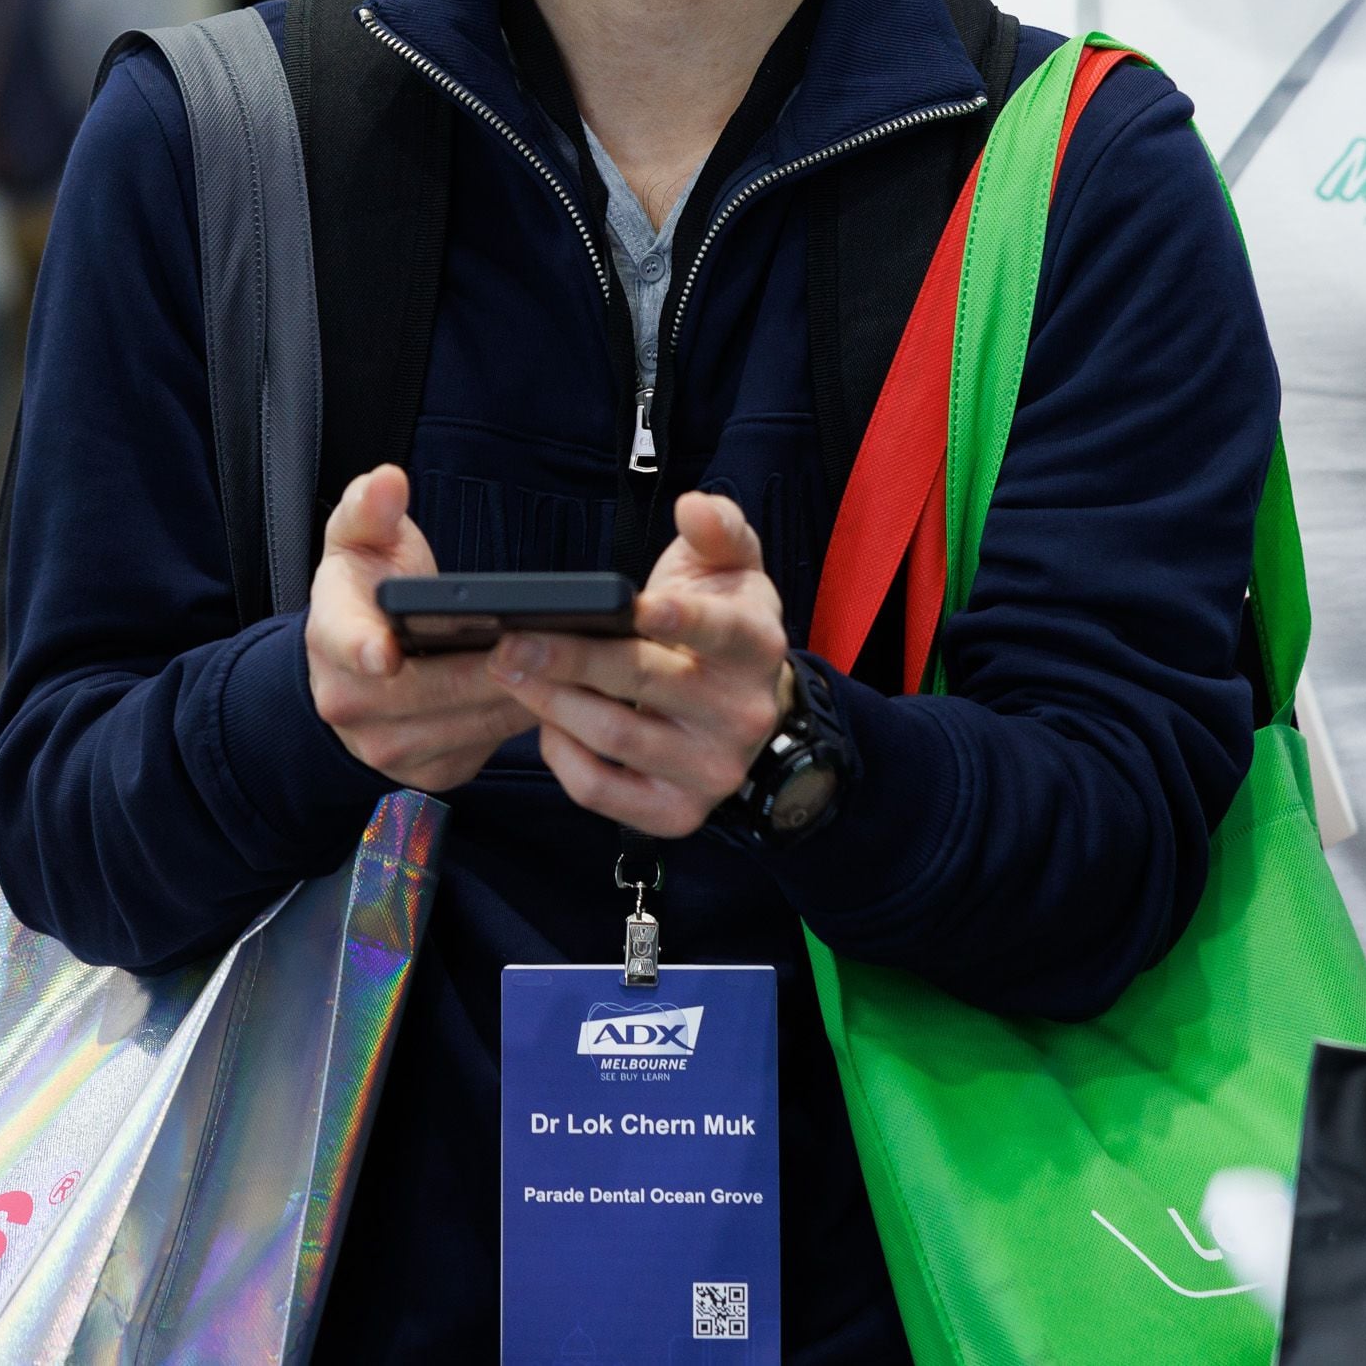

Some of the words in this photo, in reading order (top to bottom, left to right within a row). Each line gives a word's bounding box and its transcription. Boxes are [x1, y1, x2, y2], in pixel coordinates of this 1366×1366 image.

[593, 1023, 695, 1051] ADX
[600, 1058, 688, 1071] MELBOURNE
[600, 1072, 617, 1081] SEE
[620, 1072, 638, 1081] BUY
[642, 1072, 671, 1082] LEARN
[531, 1113, 560, 1133] Dr
[567, 1114, 613, 1134] Lok
[621, 1114, 696, 1135] Chern
[704, 1115, 756, 1135] Muk
[524, 1187, 584, 1203] Parade
[590, 1187, 645, 1204] Dental
[650, 1188, 705, 1204] Ocean
[711, 1189, 764, 1204] Grove
